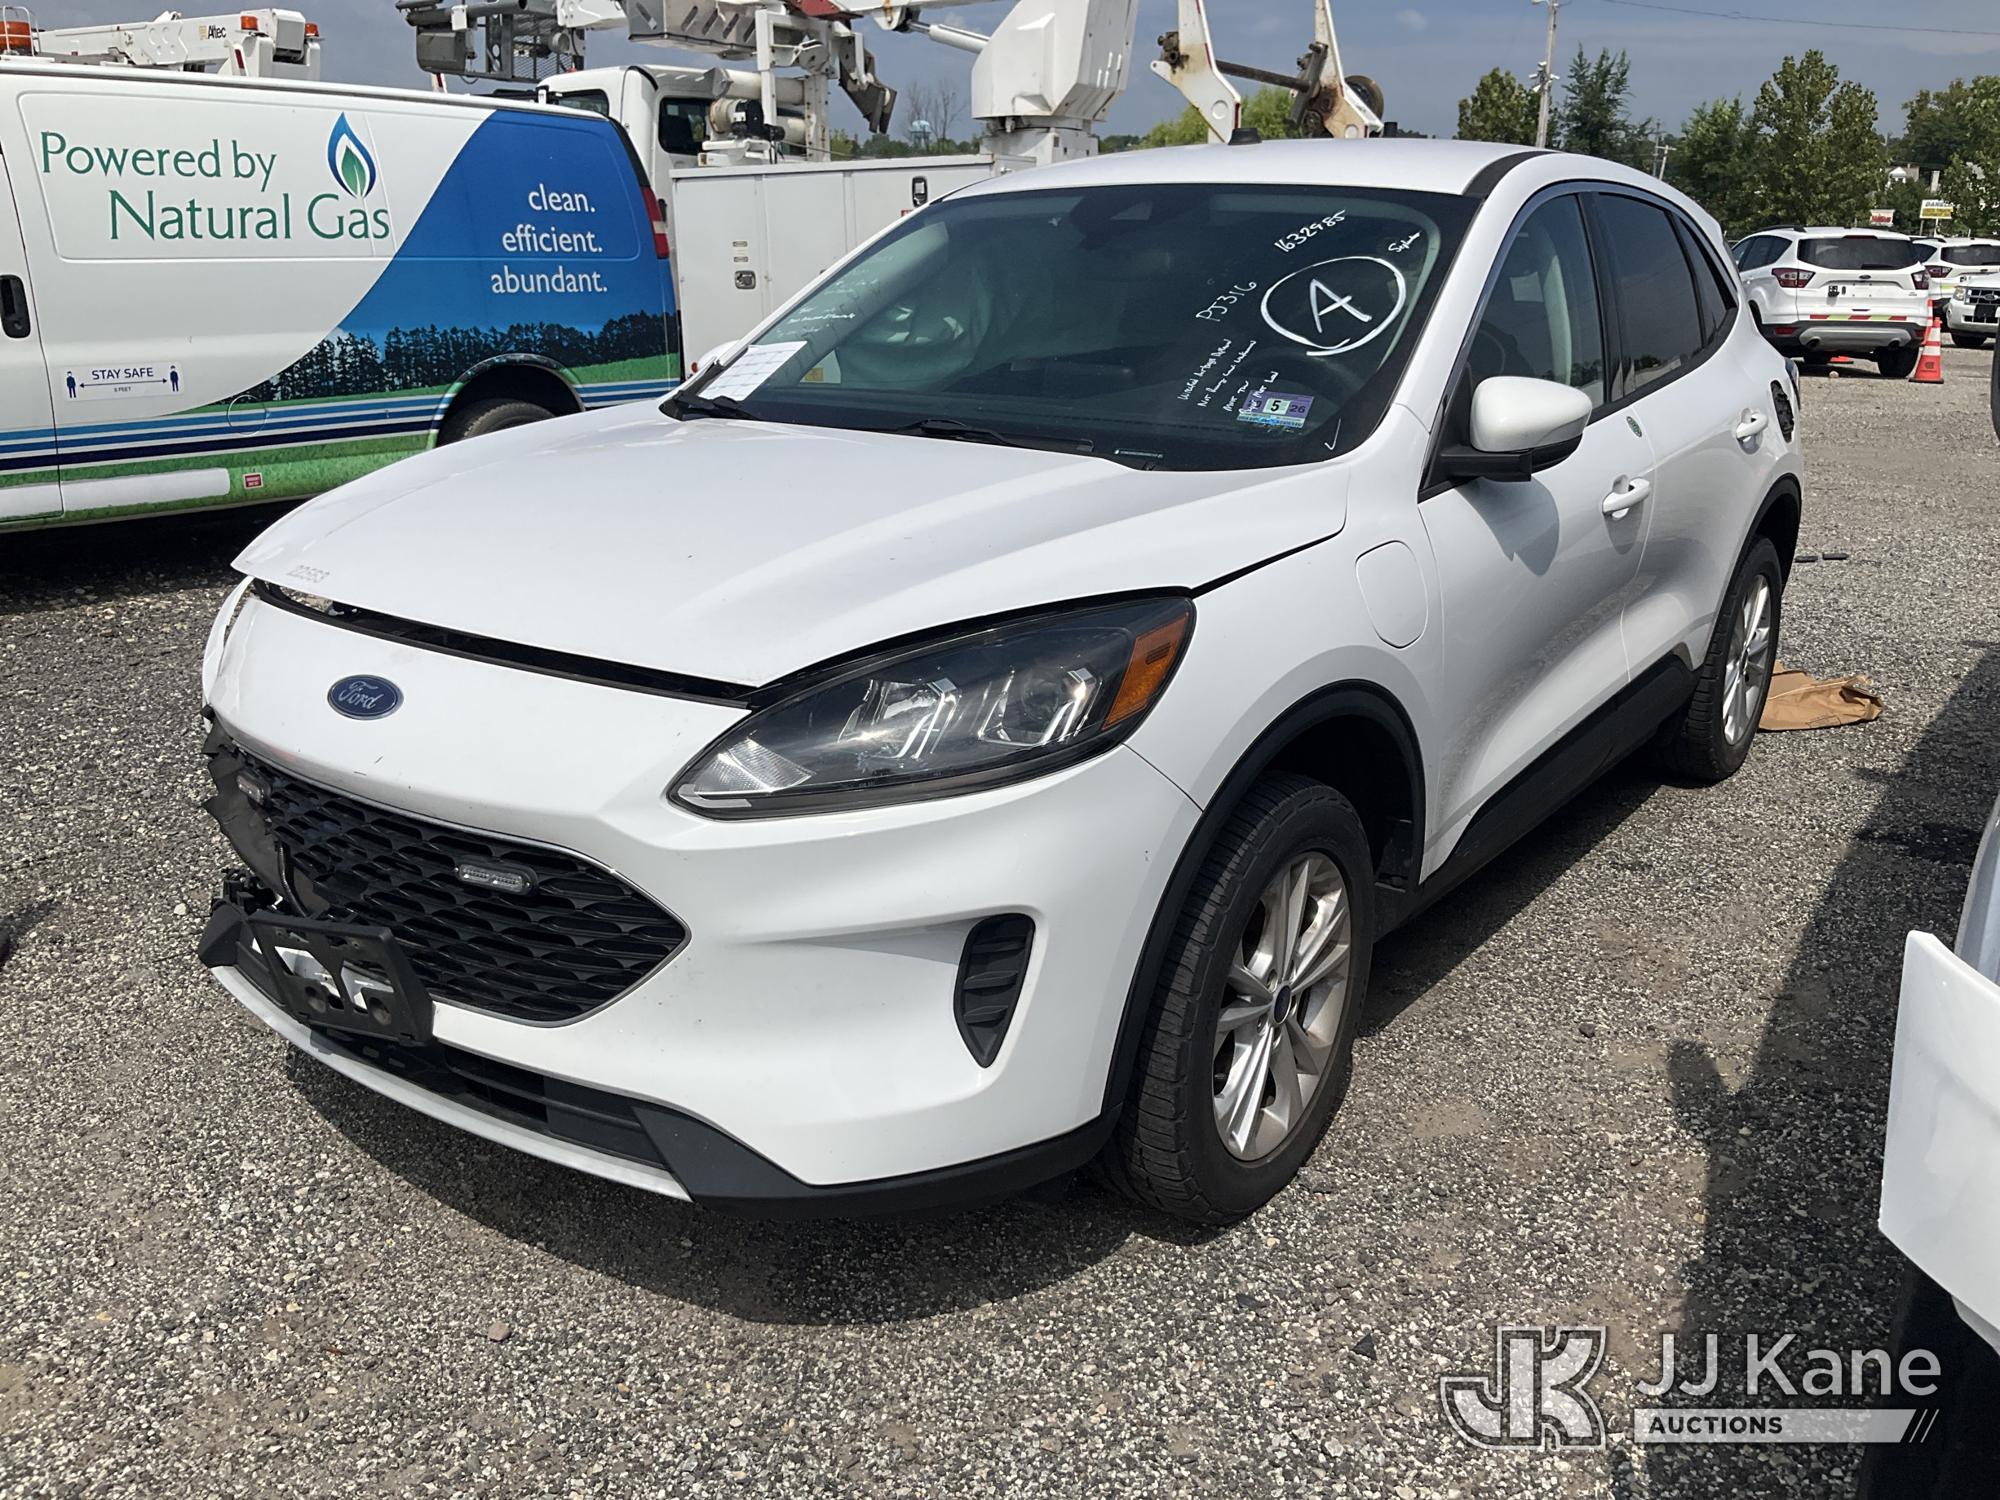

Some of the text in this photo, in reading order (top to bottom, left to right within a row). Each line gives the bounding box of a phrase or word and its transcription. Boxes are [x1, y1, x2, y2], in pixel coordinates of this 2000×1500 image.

[208, 25, 226, 39] Altec
[41, 131, 277, 192] Powered by
[528, 183, 595, 213] clean.
[108, 189, 390, 240] Natural Gas
[502, 224, 603, 253] efficient.
[490, 265, 608, 294] abundant.
[1309, 277, 1373, 333] A
[91, 367, 154, 380] STAY SAFE
[1270, 400, 1281, 412] 5
[1290, 404, 1306, 414] 26
[338, 681, 385, 710] Ford
